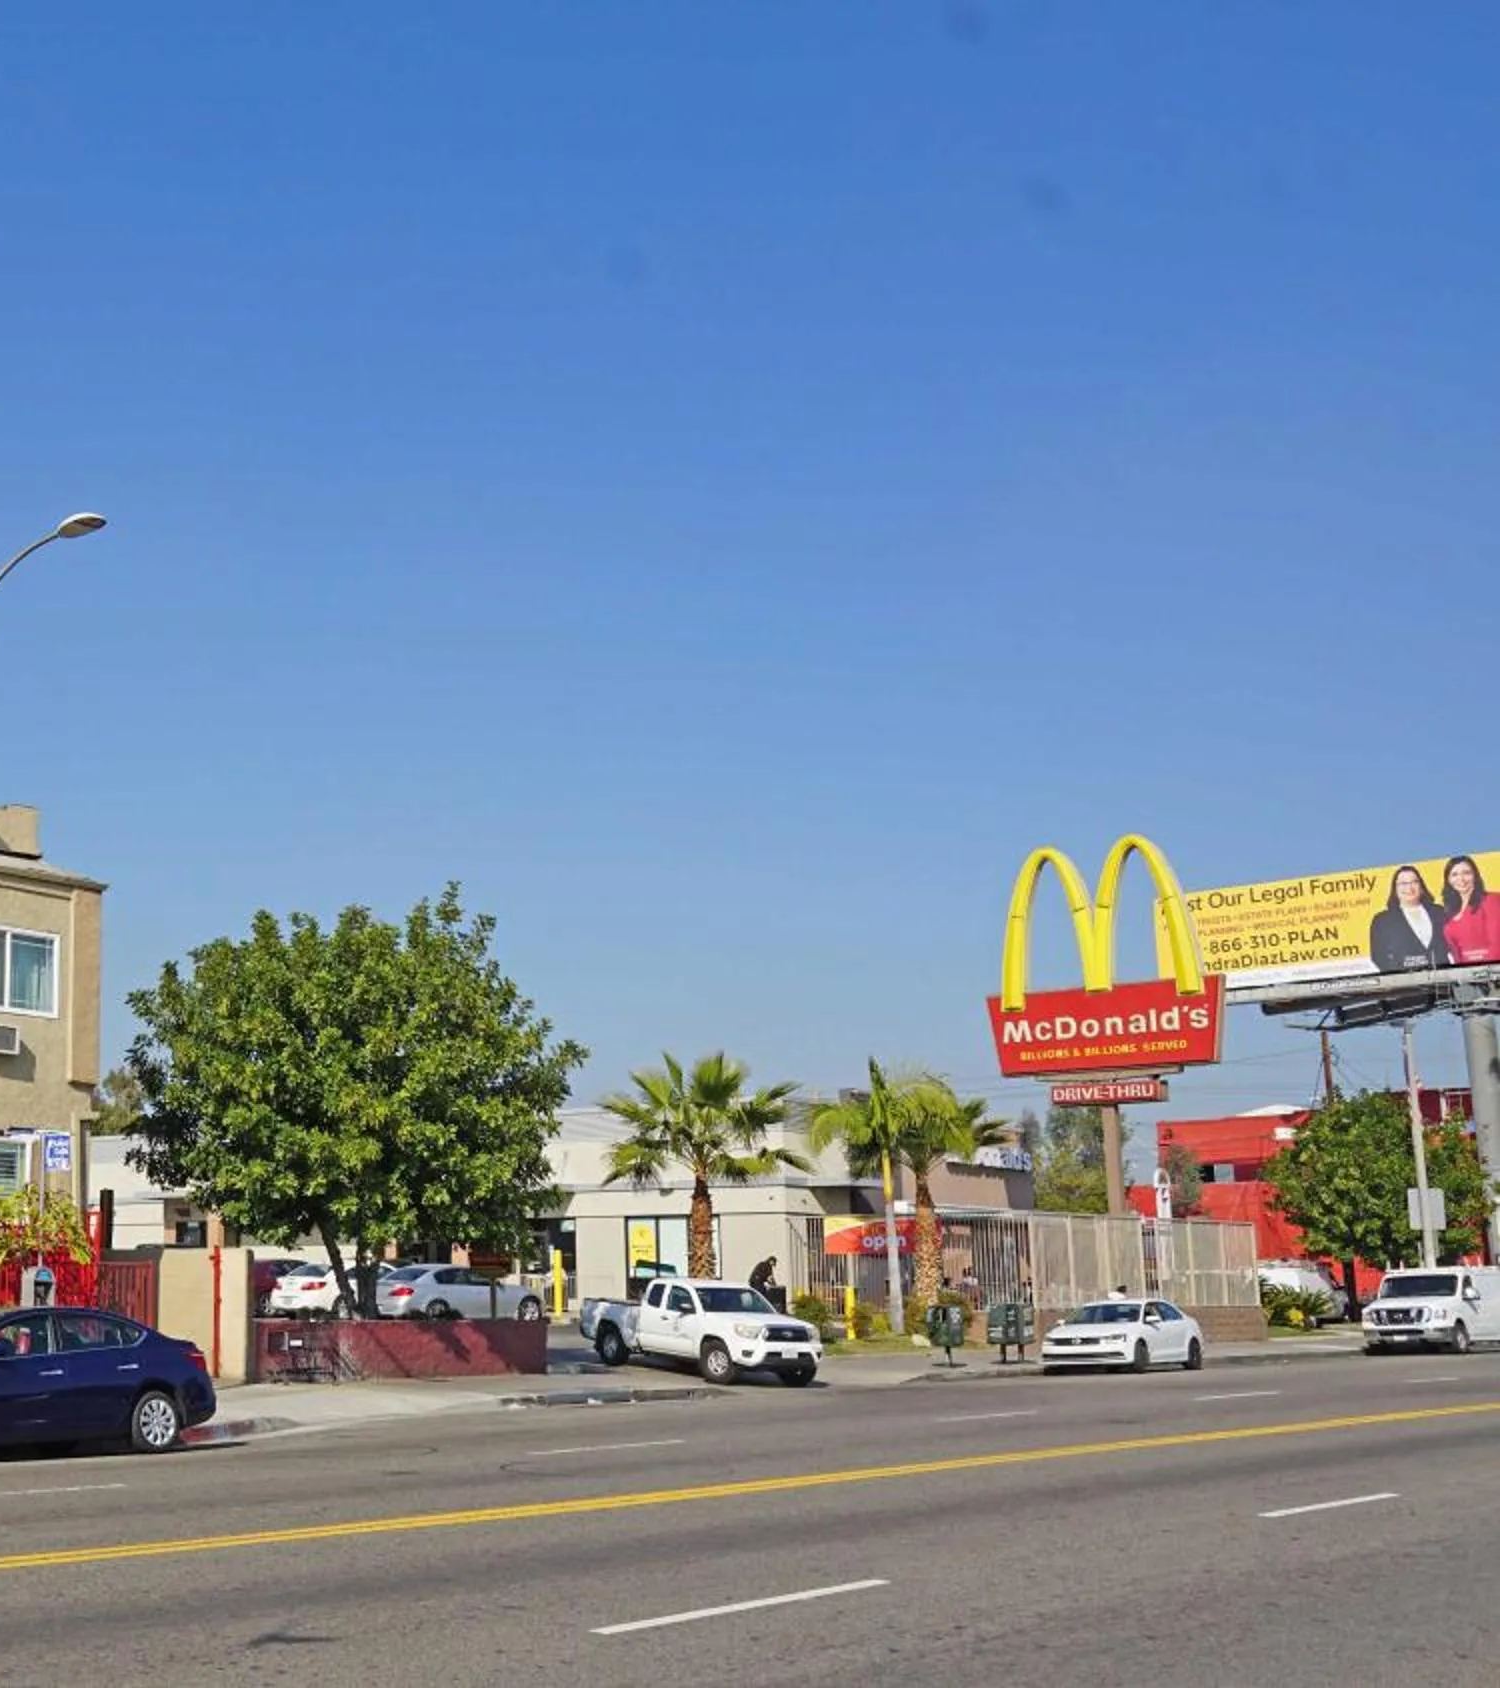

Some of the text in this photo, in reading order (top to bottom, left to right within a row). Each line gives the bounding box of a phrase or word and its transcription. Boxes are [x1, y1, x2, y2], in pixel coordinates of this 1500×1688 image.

[1209, 890, 1244, 909] Our
[1250, 881, 1304, 905] Legal
[1310, 872, 1377, 894] Family
[1203, 927, 1339, 955] -866-310-PLAN
[1204, 945, 1360, 972] ndraDiazLaw.com
[1003, 1005, 1209, 1044] McDonald's
[1084, 1043, 1137, 1056] BILLIONS
[1143, 1039, 1187, 1051] SERVED
[1053, 1084, 1154, 1101] DRIVE-THRU
[862, 1236, 907, 1252] opn
